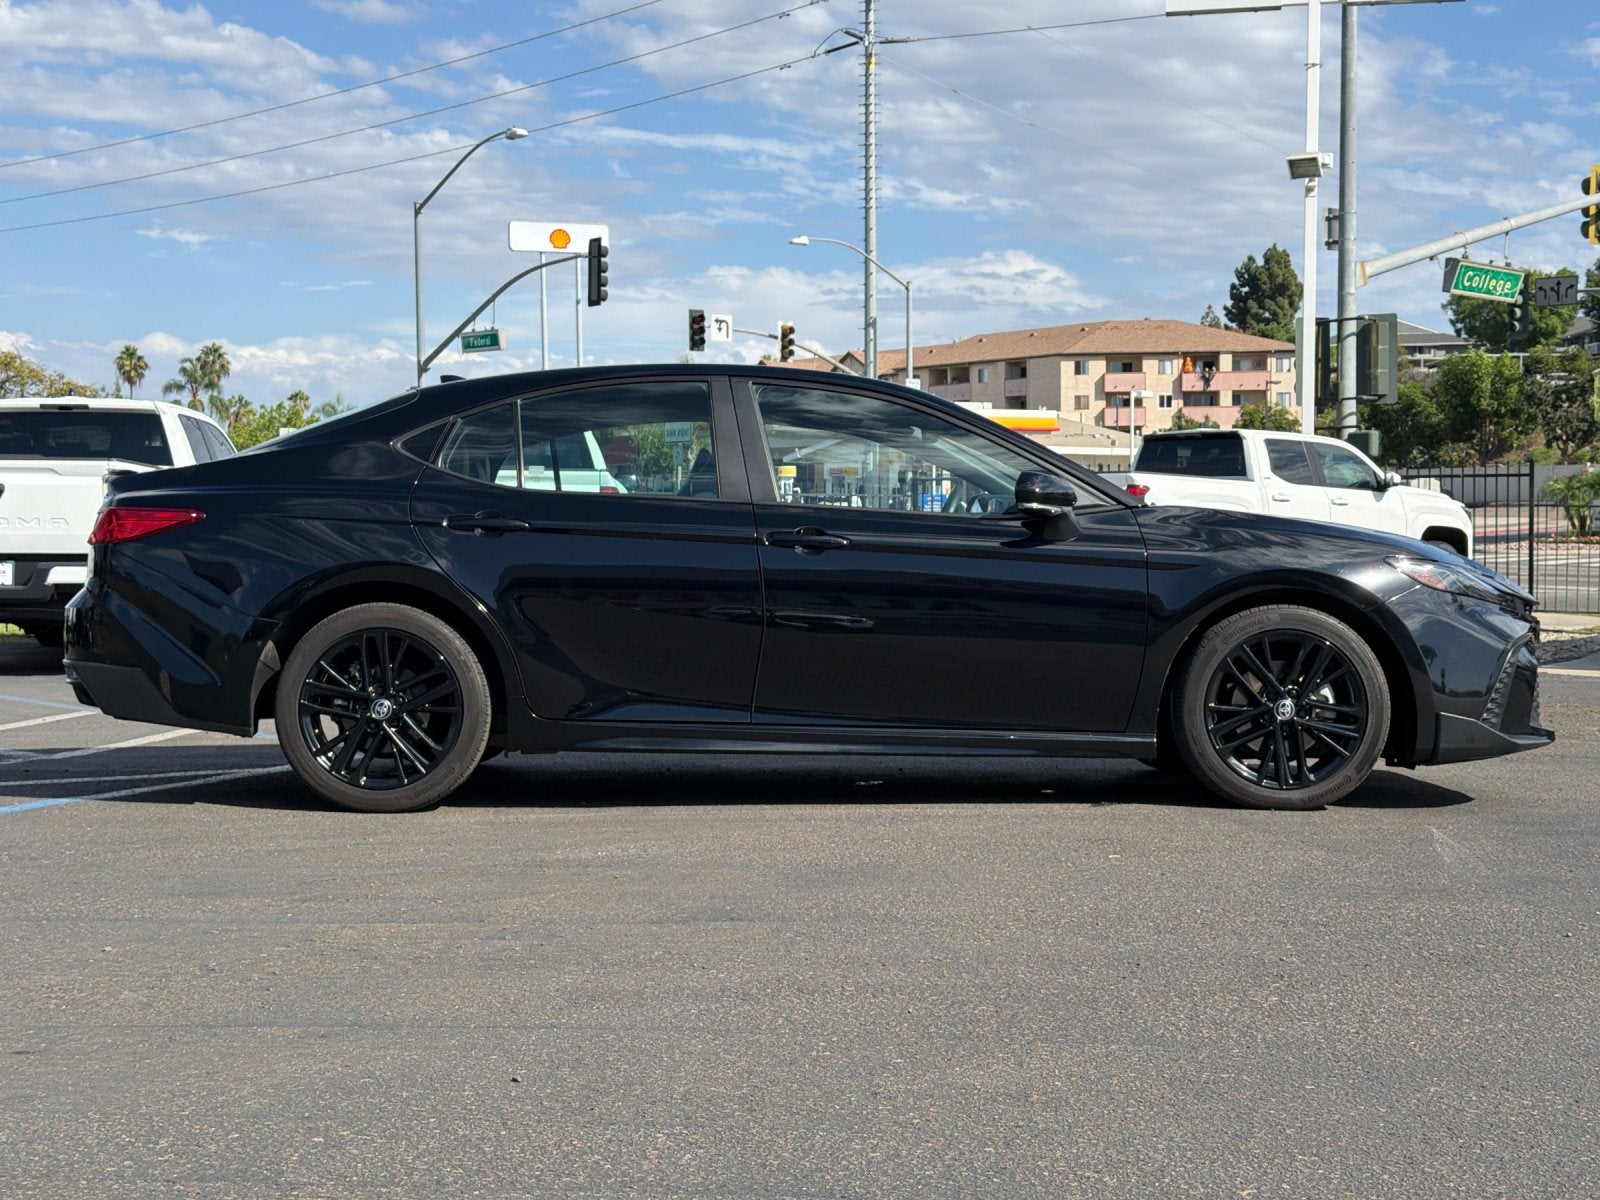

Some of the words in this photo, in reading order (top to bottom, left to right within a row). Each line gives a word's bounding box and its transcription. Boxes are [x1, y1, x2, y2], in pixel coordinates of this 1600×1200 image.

[1464, 271, 1512, 295] College
[470, 336, 491, 347] Federal
[1221, 615, 1264, 644] Continental
[1308, 775, 1352, 802] Continental
